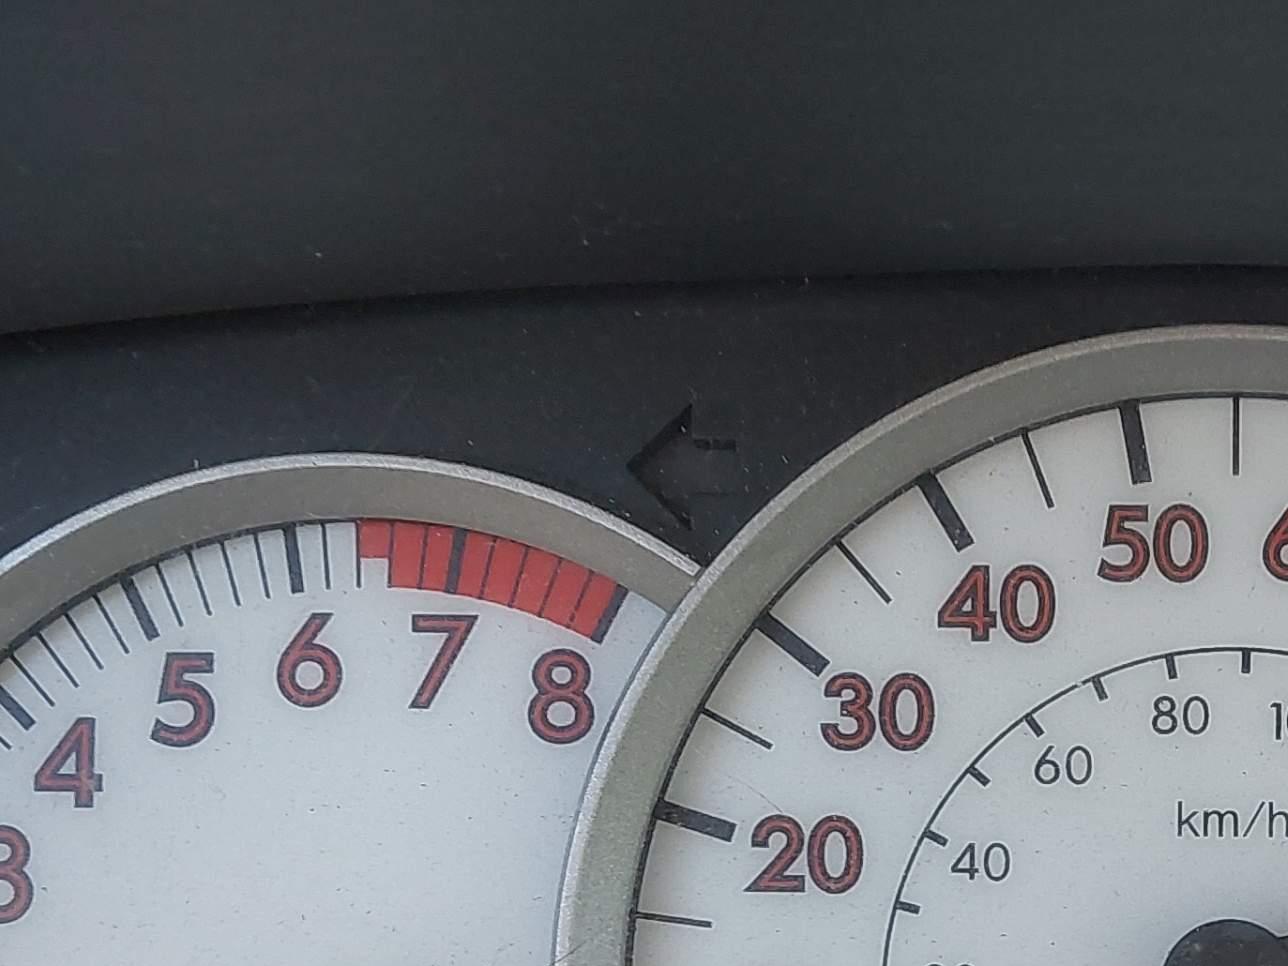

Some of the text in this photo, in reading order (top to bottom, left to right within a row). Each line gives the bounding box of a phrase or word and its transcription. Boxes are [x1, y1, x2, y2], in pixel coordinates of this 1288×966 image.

[1096, 504, 1208, 583] 50
[937, 565, 1055, 643] 40
[150, 653, 215, 747] 5
[276, 613, 343, 708] 6
[408, 615, 478, 709] 7
[528, 648, 594, 744] 8
[820, 672, 935, 751] 30
[1152, 696, 1209, 734] 80
[33, 717, 102, 808] 4
[1034, 746, 1093, 785] 60
[744, 815, 864, 894] 20
[951, 843, 1010, 881] 40
